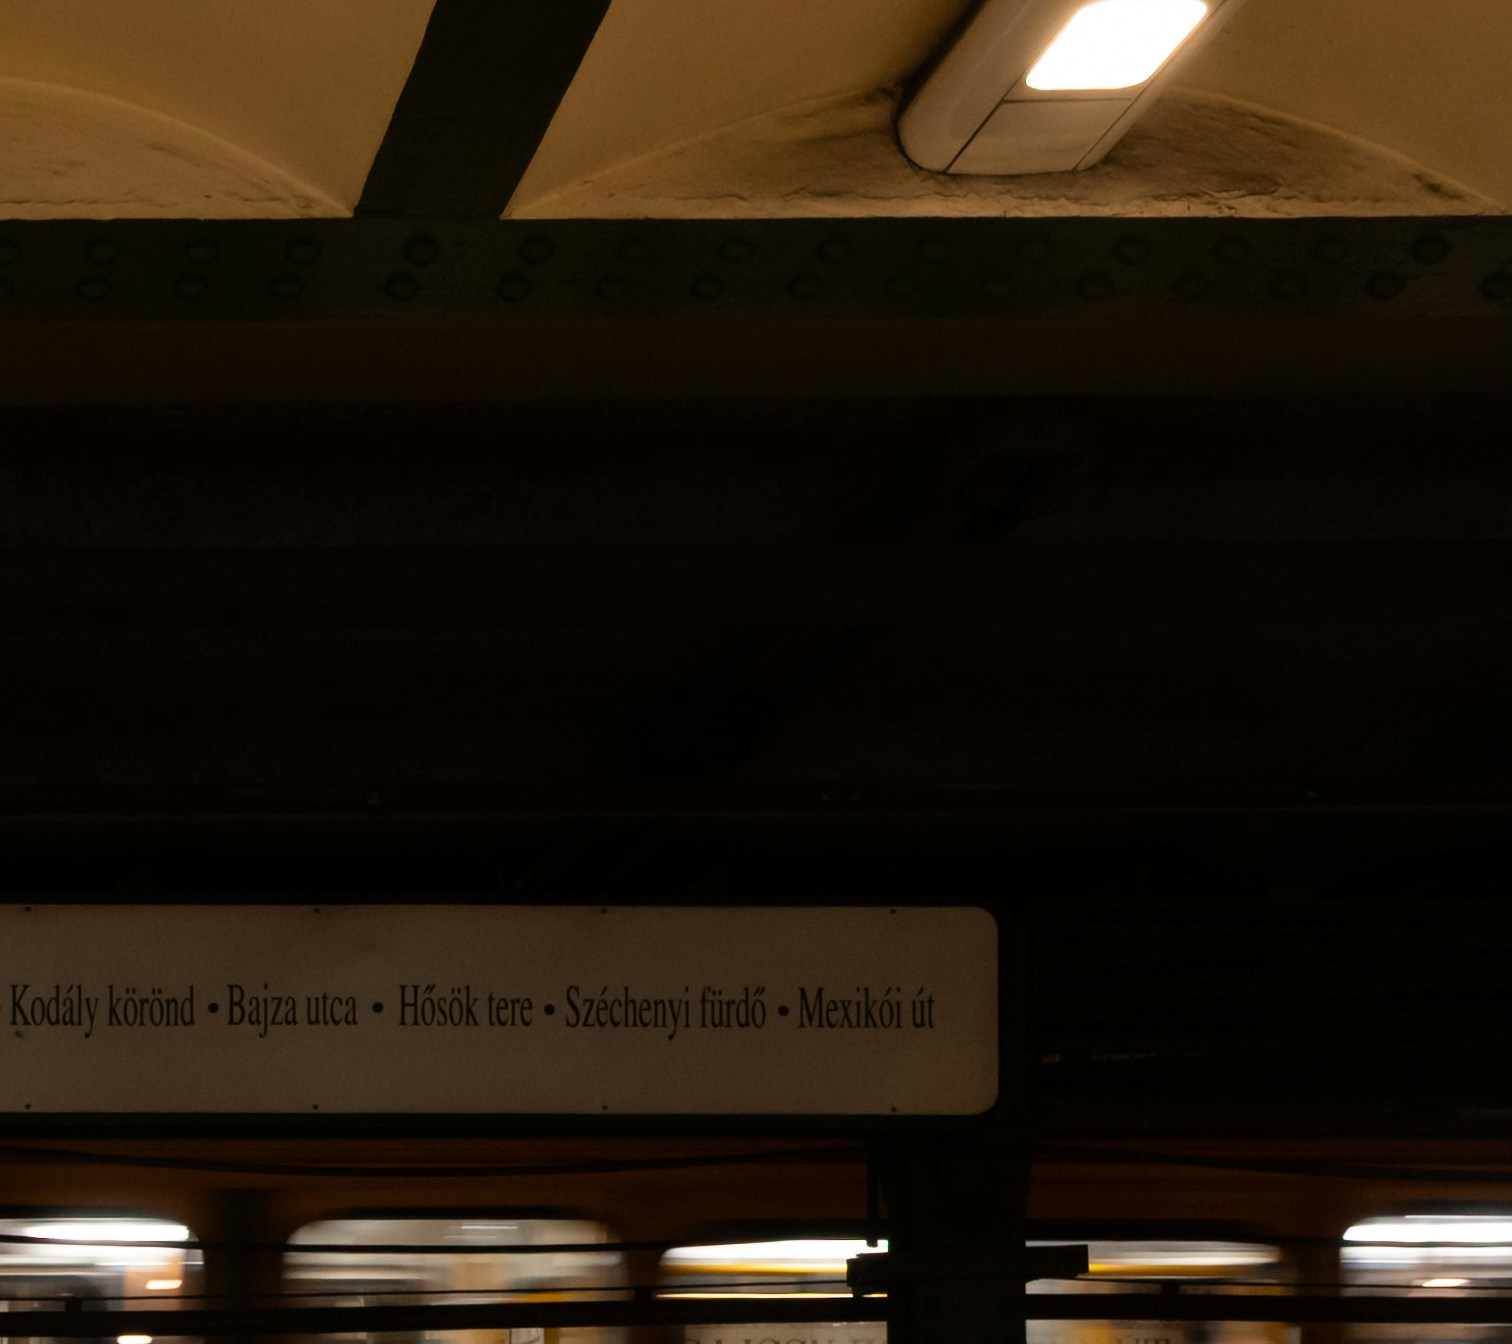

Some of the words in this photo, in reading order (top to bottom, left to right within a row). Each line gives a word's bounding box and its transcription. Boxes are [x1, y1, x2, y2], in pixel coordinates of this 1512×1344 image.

[9, 983, 98, 1039] Kodály
[107, 983, 195, 1027] körönd
[227, 983, 298, 1038] Bajza
[306, 991, 358, 1027] utca
[398, 983, 479, 1027] Hősök
[487, 991, 533, 1027] tere
[564, 984, 690, 1041] Széchenyi
[699, 985, 767, 1029] fürdő
[797, 986, 902, 1029] Mexikói
[910, 986, 935, 1029] út
